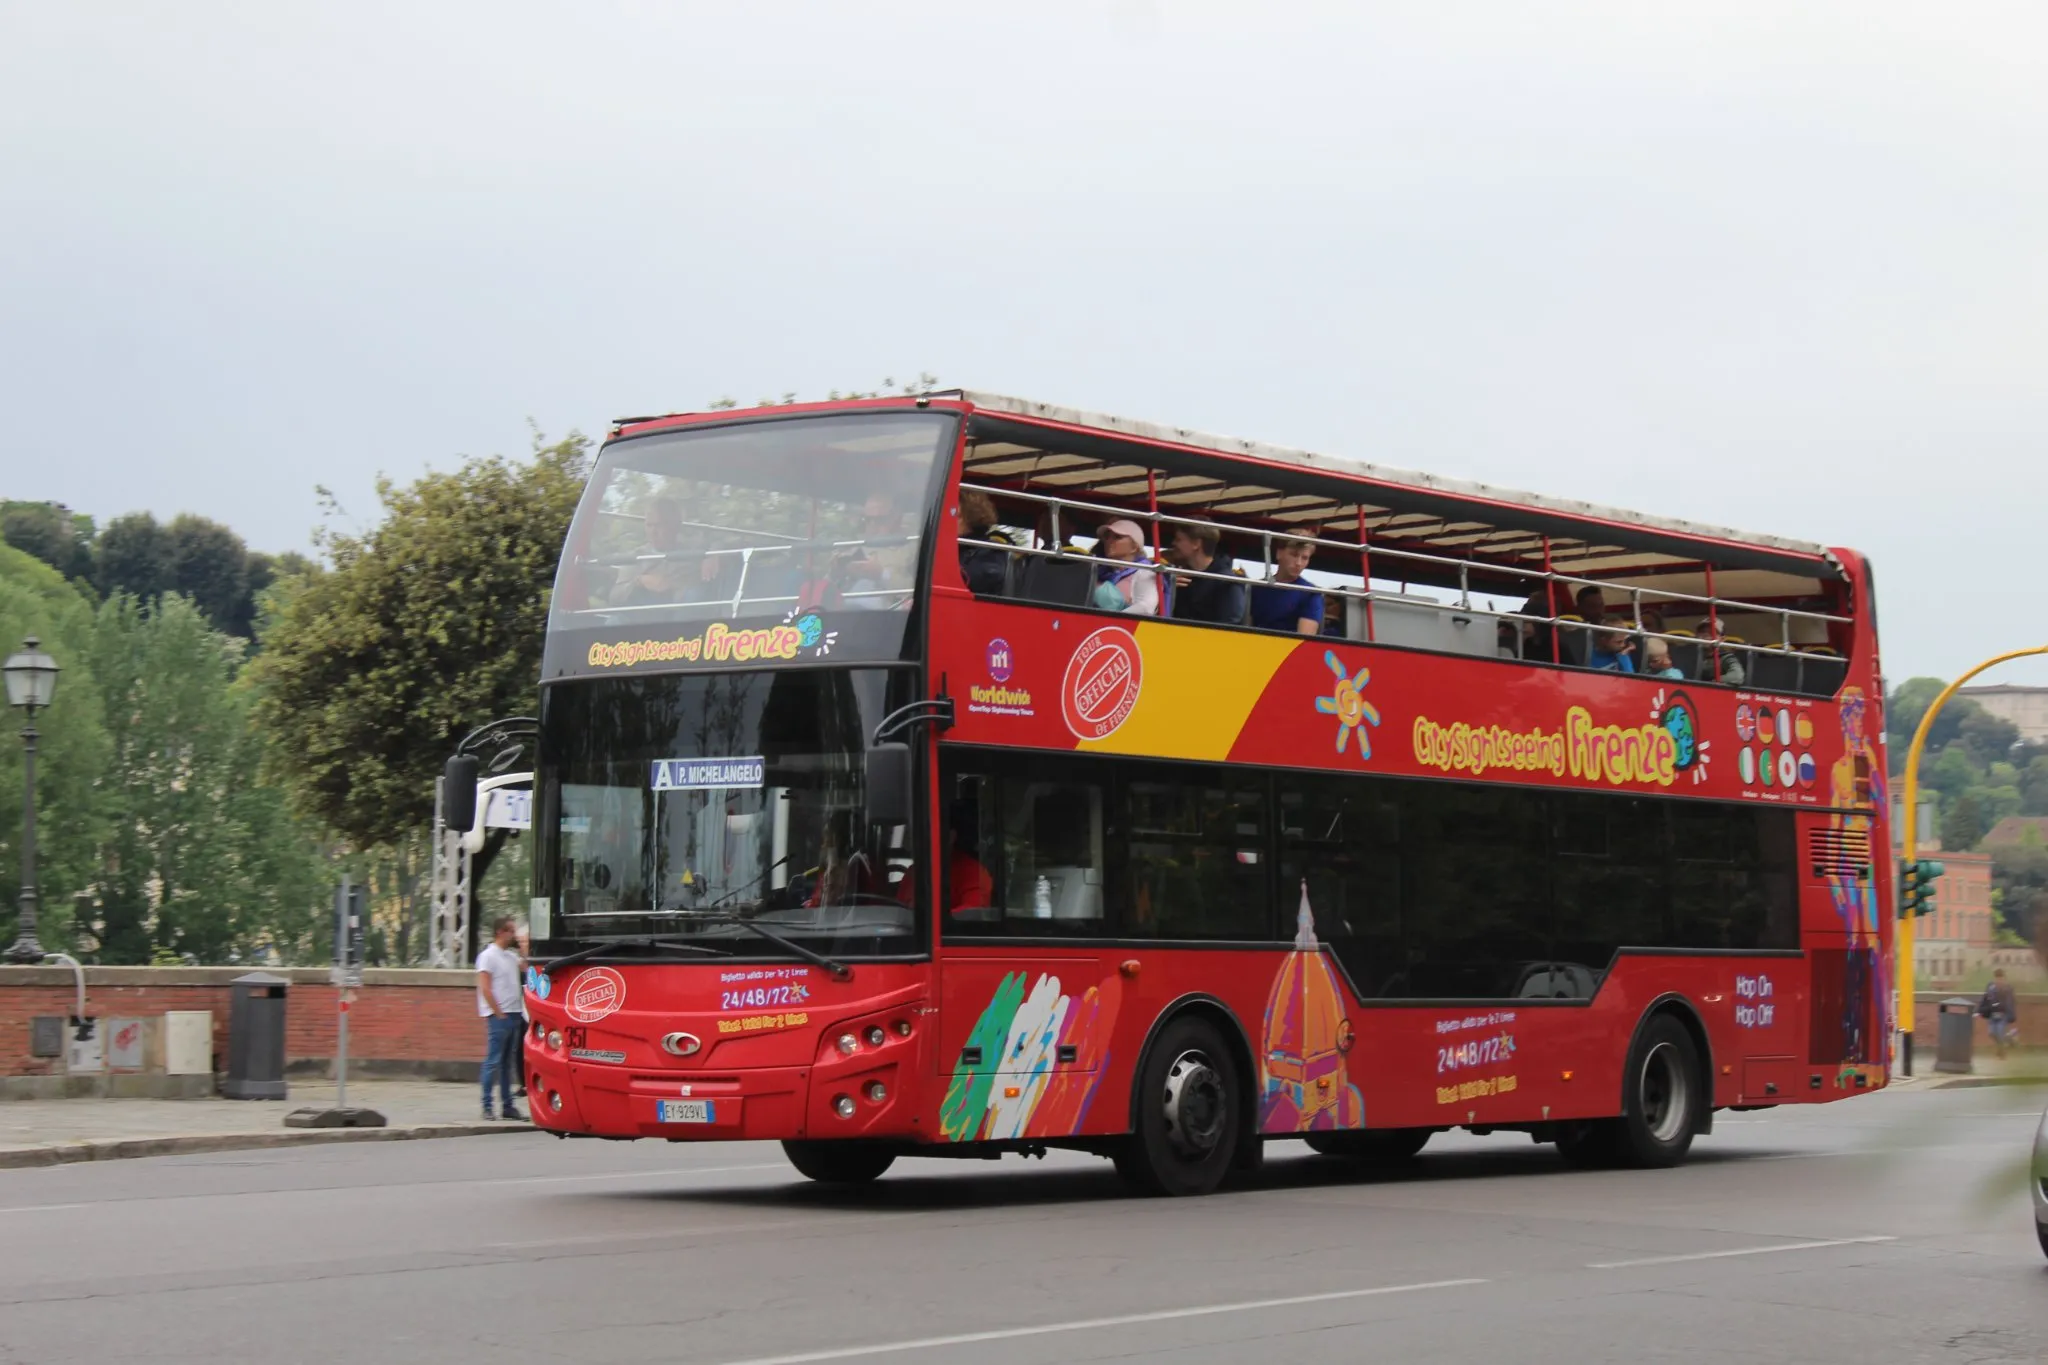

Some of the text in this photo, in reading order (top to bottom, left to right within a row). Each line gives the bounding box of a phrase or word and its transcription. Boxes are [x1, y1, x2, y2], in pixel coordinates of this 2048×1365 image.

[588, 623, 799, 667] CitySightseeing Firenze
[1076, 636, 1103, 665] TOUR
[971, 686, 1031, 705] Worldwide
[1078, 655, 1129, 712] OFFICIAL
[1095, 680, 1138, 736] OF FIRENZE
[1413, 706, 1676, 786] CitySightseeing Firenze
[655, 761, 673, 787] A
[679, 764, 762, 784] P. MICHELANGELO
[576, 986, 615, 1006] OFFICIAL
[722, 986, 790, 1009] 24/48/72
[1736, 974, 1773, 999] Hop On
[1736, 1003, 1776, 1028] Hop Off
[1438, 1037, 1500, 1073] 24/48/72
